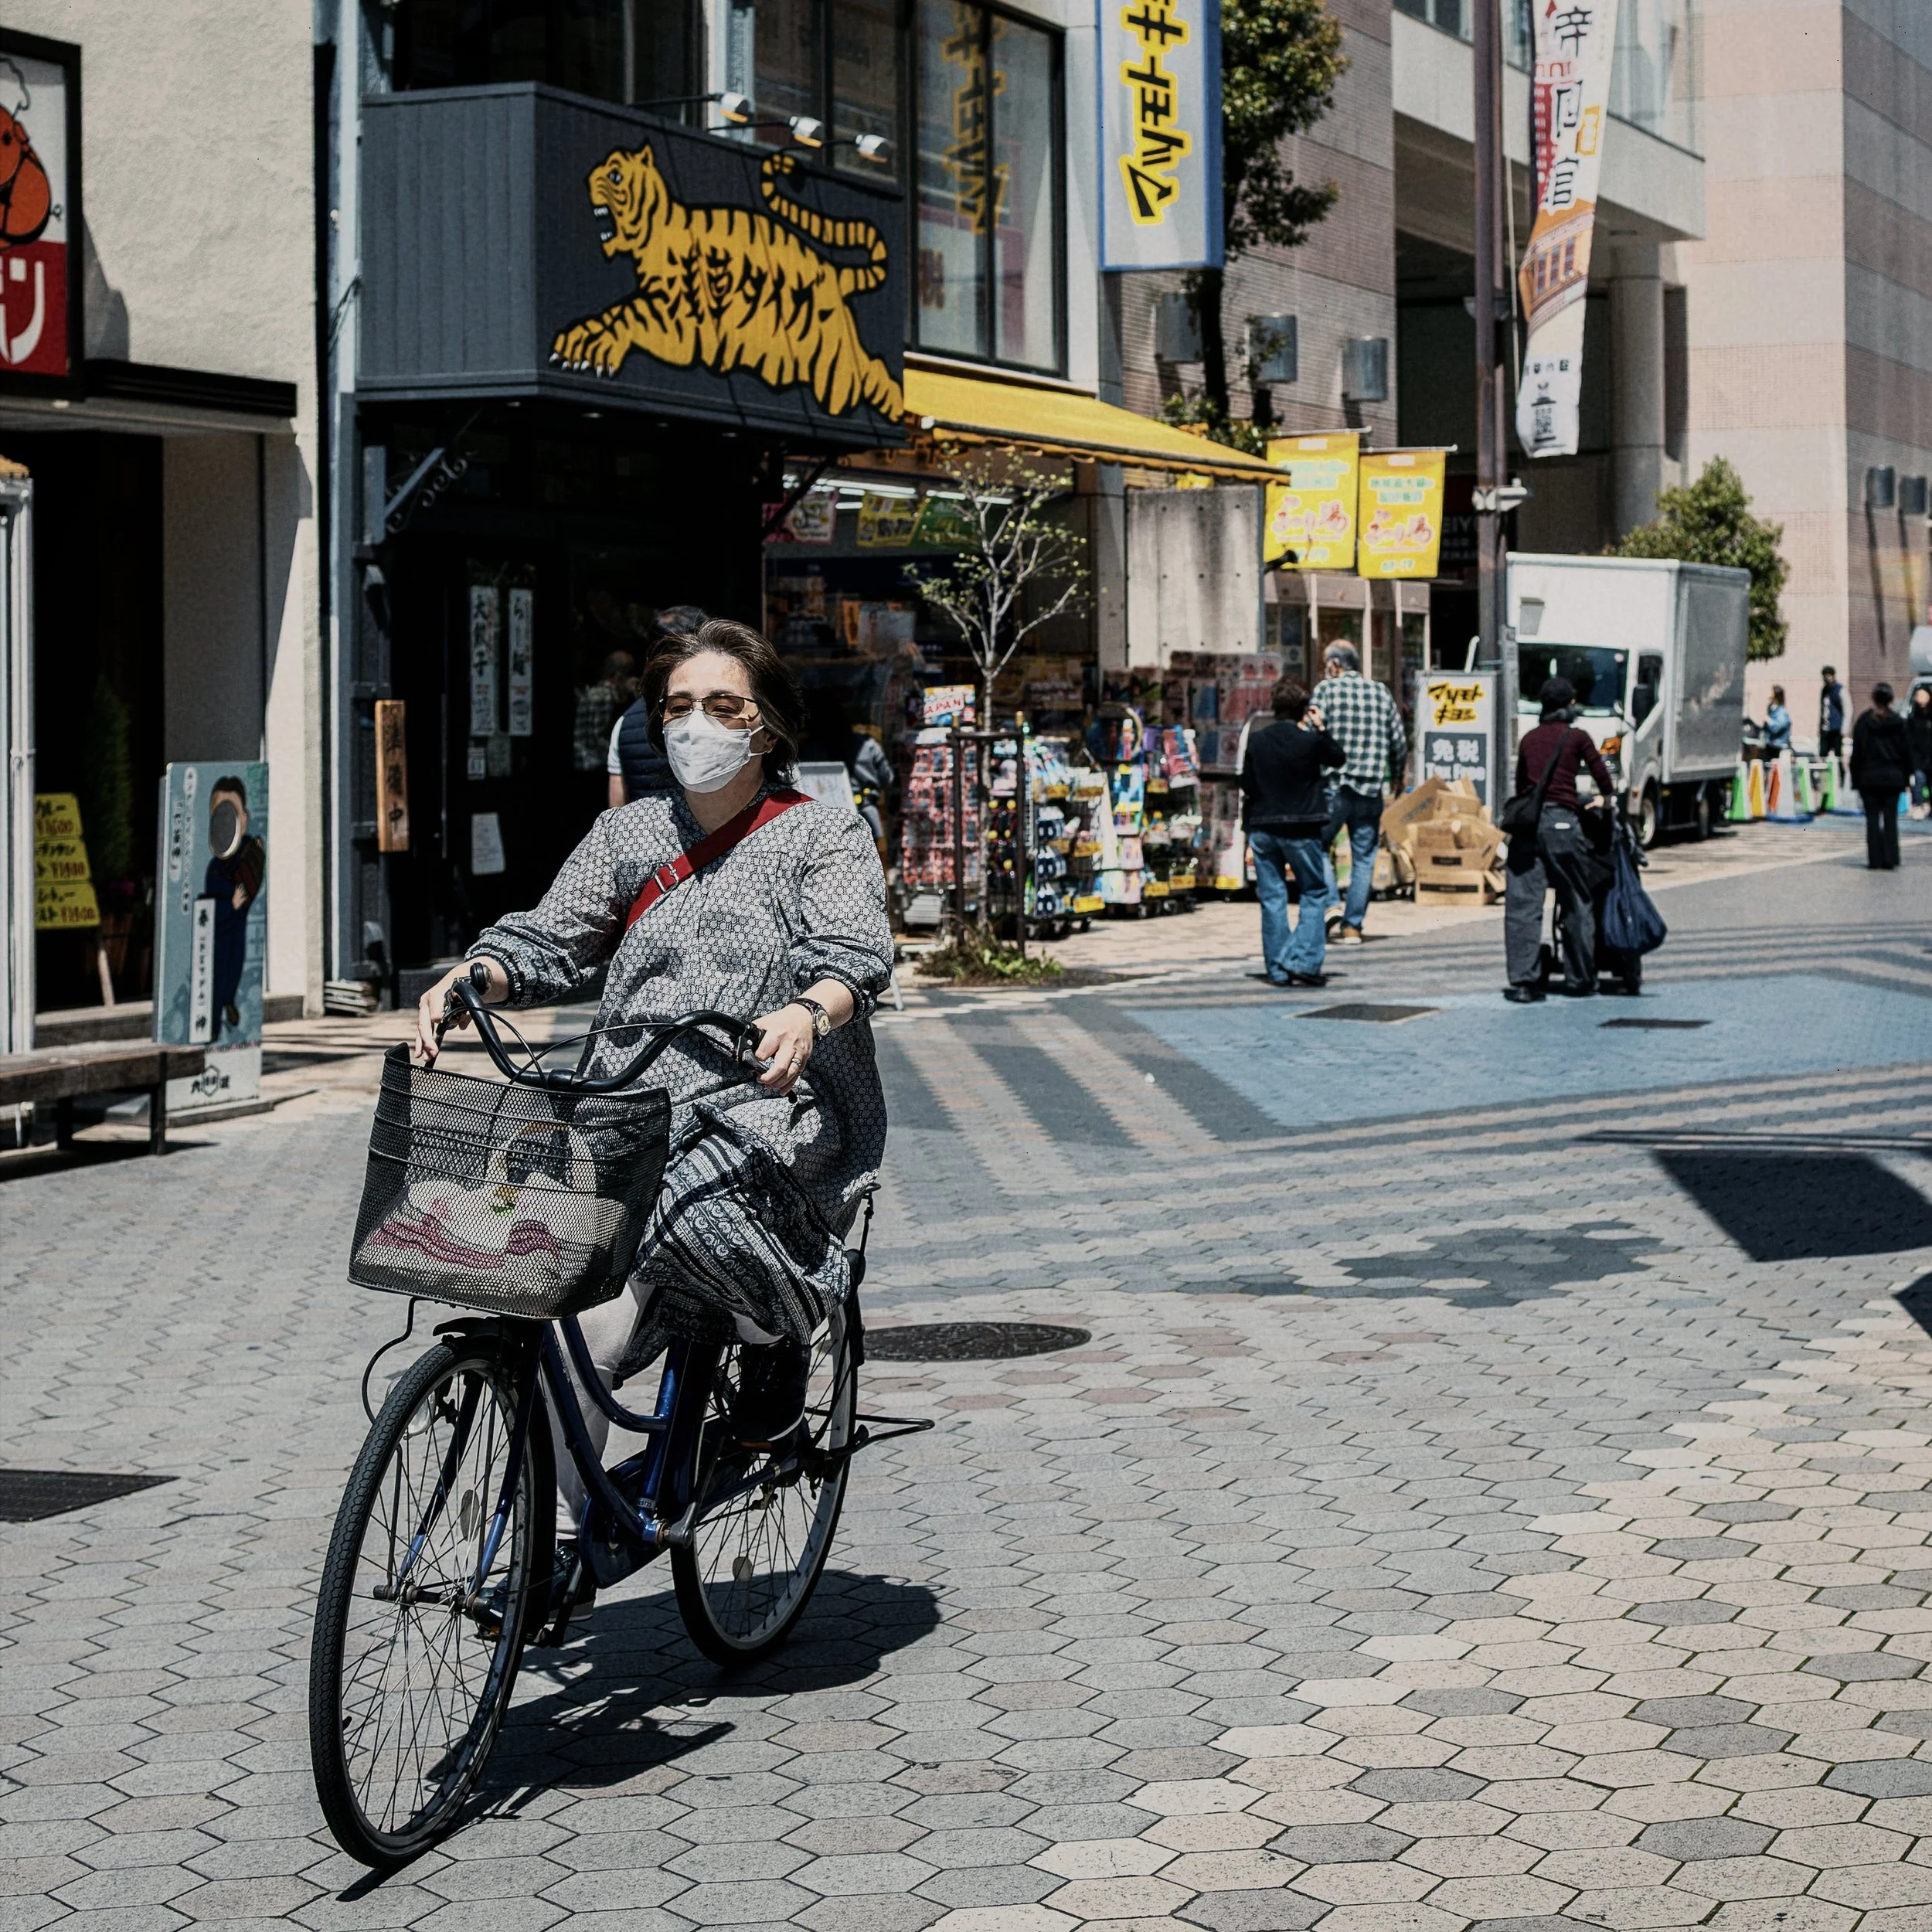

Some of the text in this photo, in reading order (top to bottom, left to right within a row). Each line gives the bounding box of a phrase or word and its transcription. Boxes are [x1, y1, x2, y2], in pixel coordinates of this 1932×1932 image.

[1125, 0, 1185, 218] マツモトキ
[923, 698, 961, 716] APAN
[1433, 739, 1479, 763] 免税
